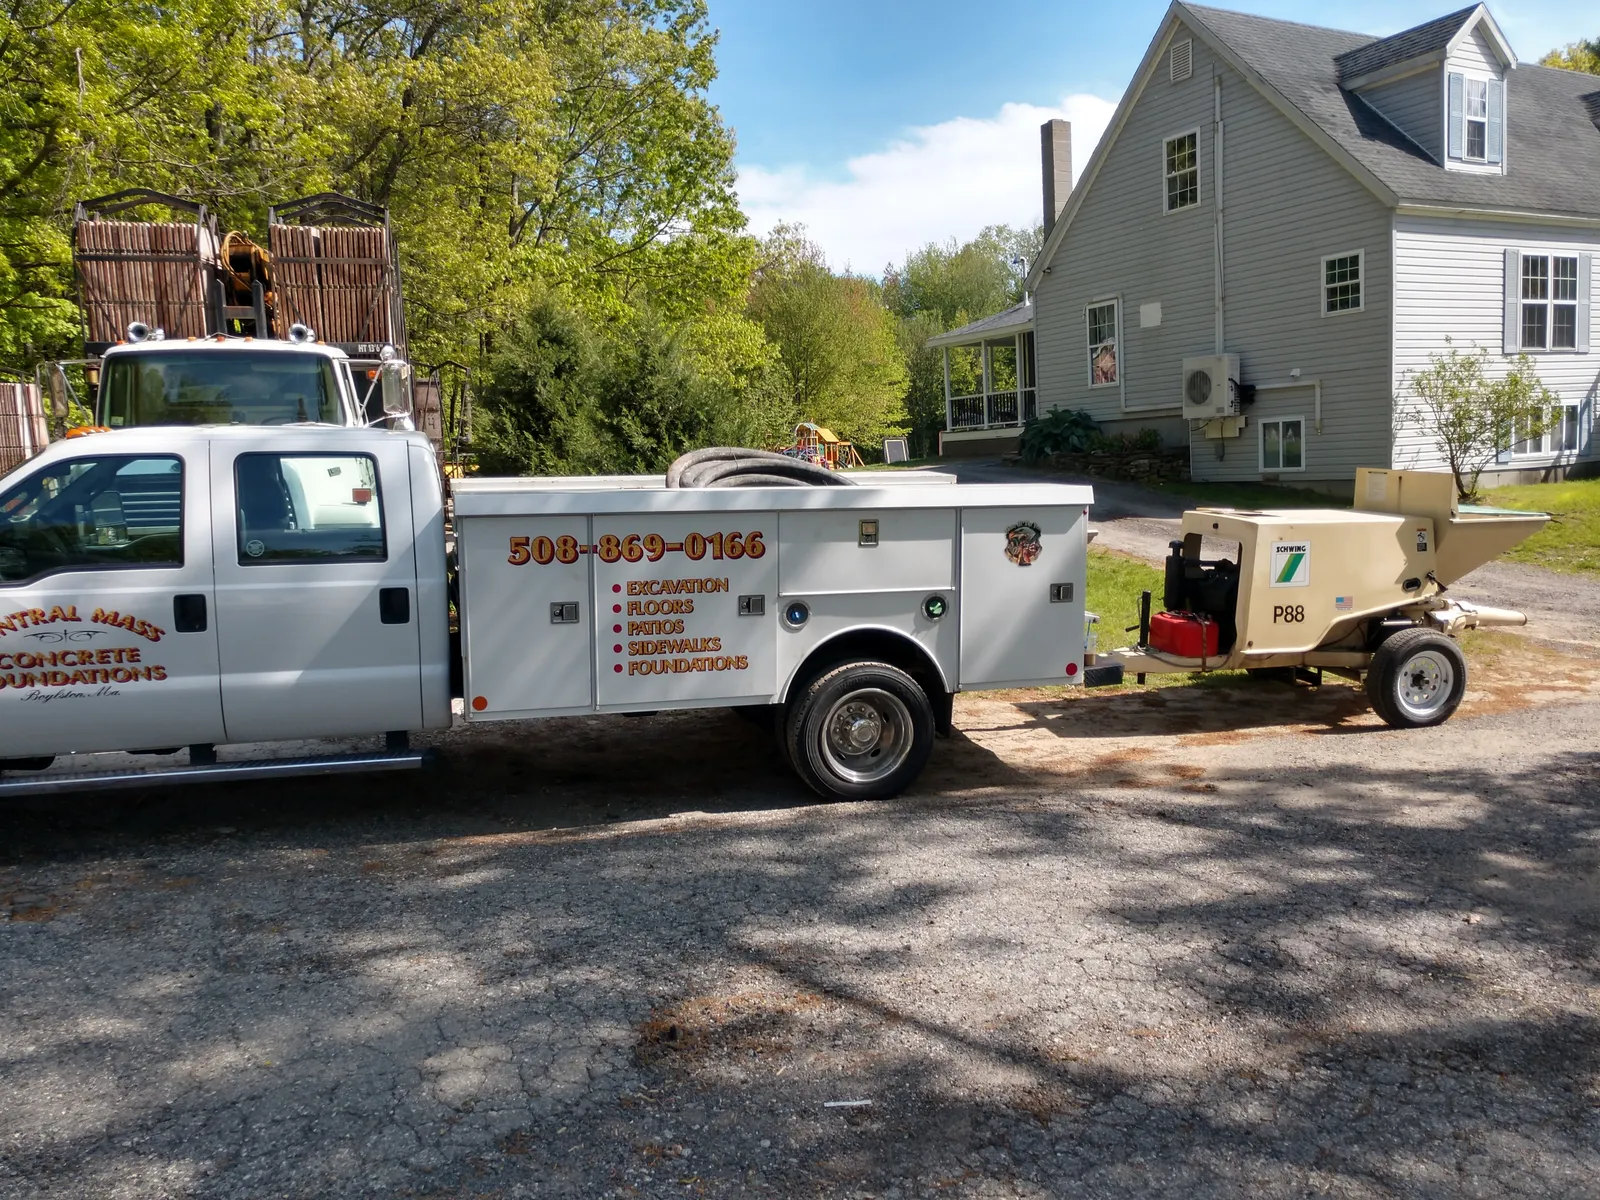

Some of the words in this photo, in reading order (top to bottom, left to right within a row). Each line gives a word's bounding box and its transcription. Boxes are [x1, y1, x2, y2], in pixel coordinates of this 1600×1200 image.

[358, 344, 367, 353] HT
[508, 531, 766, 566] 508-869-0166
[1276, 545, 1307, 553] SCHWING
[627, 577, 729, 596] EXCAVATION
[627, 599, 694, 616] FLOORS
[1273, 605, 1305, 624] P88
[0, 605, 82, 637] NTRAL
[91, 607, 166, 642] MASS
[627, 619, 684, 636] PATIOS
[628, 637, 722, 656] SIDEWALKS
[0, 647, 141, 670] CONCRETE
[628, 655, 749, 676] FOUNDATIONS
[0, 665, 168, 690] UNDATIONS
